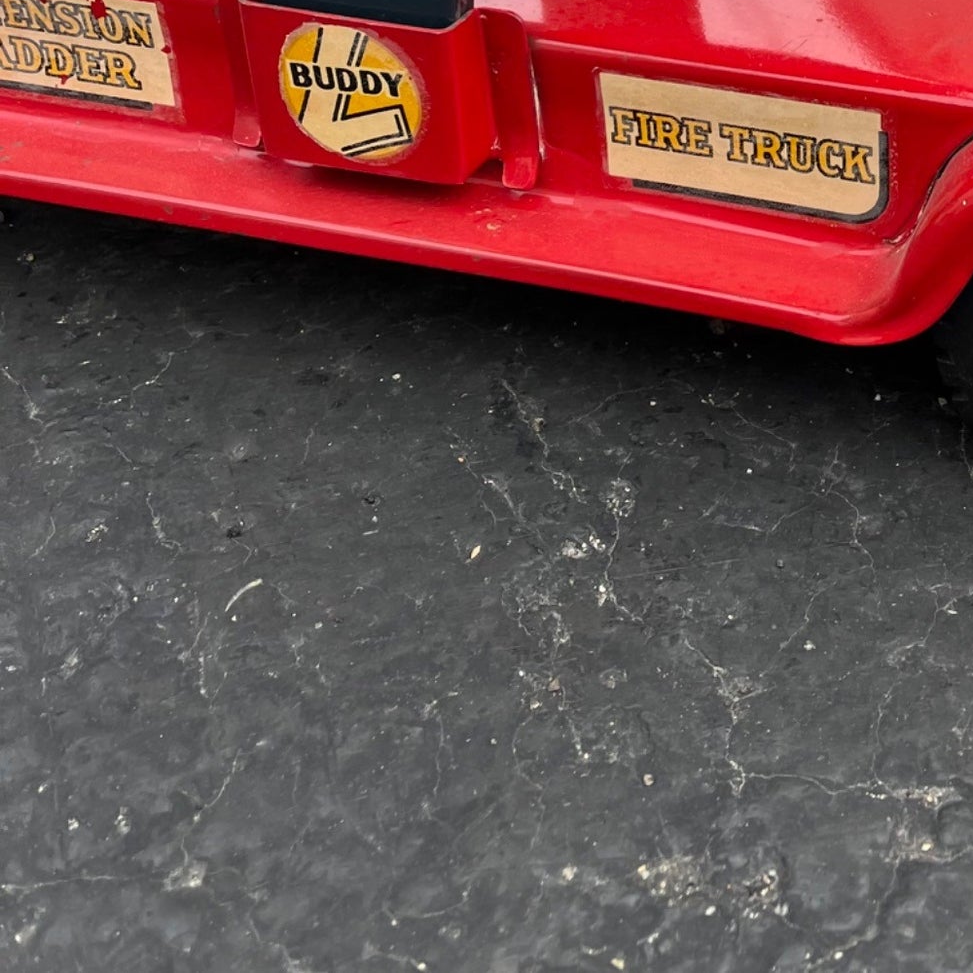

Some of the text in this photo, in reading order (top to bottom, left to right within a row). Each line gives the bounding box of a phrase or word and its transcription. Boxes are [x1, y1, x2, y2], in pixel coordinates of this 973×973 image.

[289, 62, 404, 98] BUDDY
[608, 106, 876, 185] FIRE TRUCK
